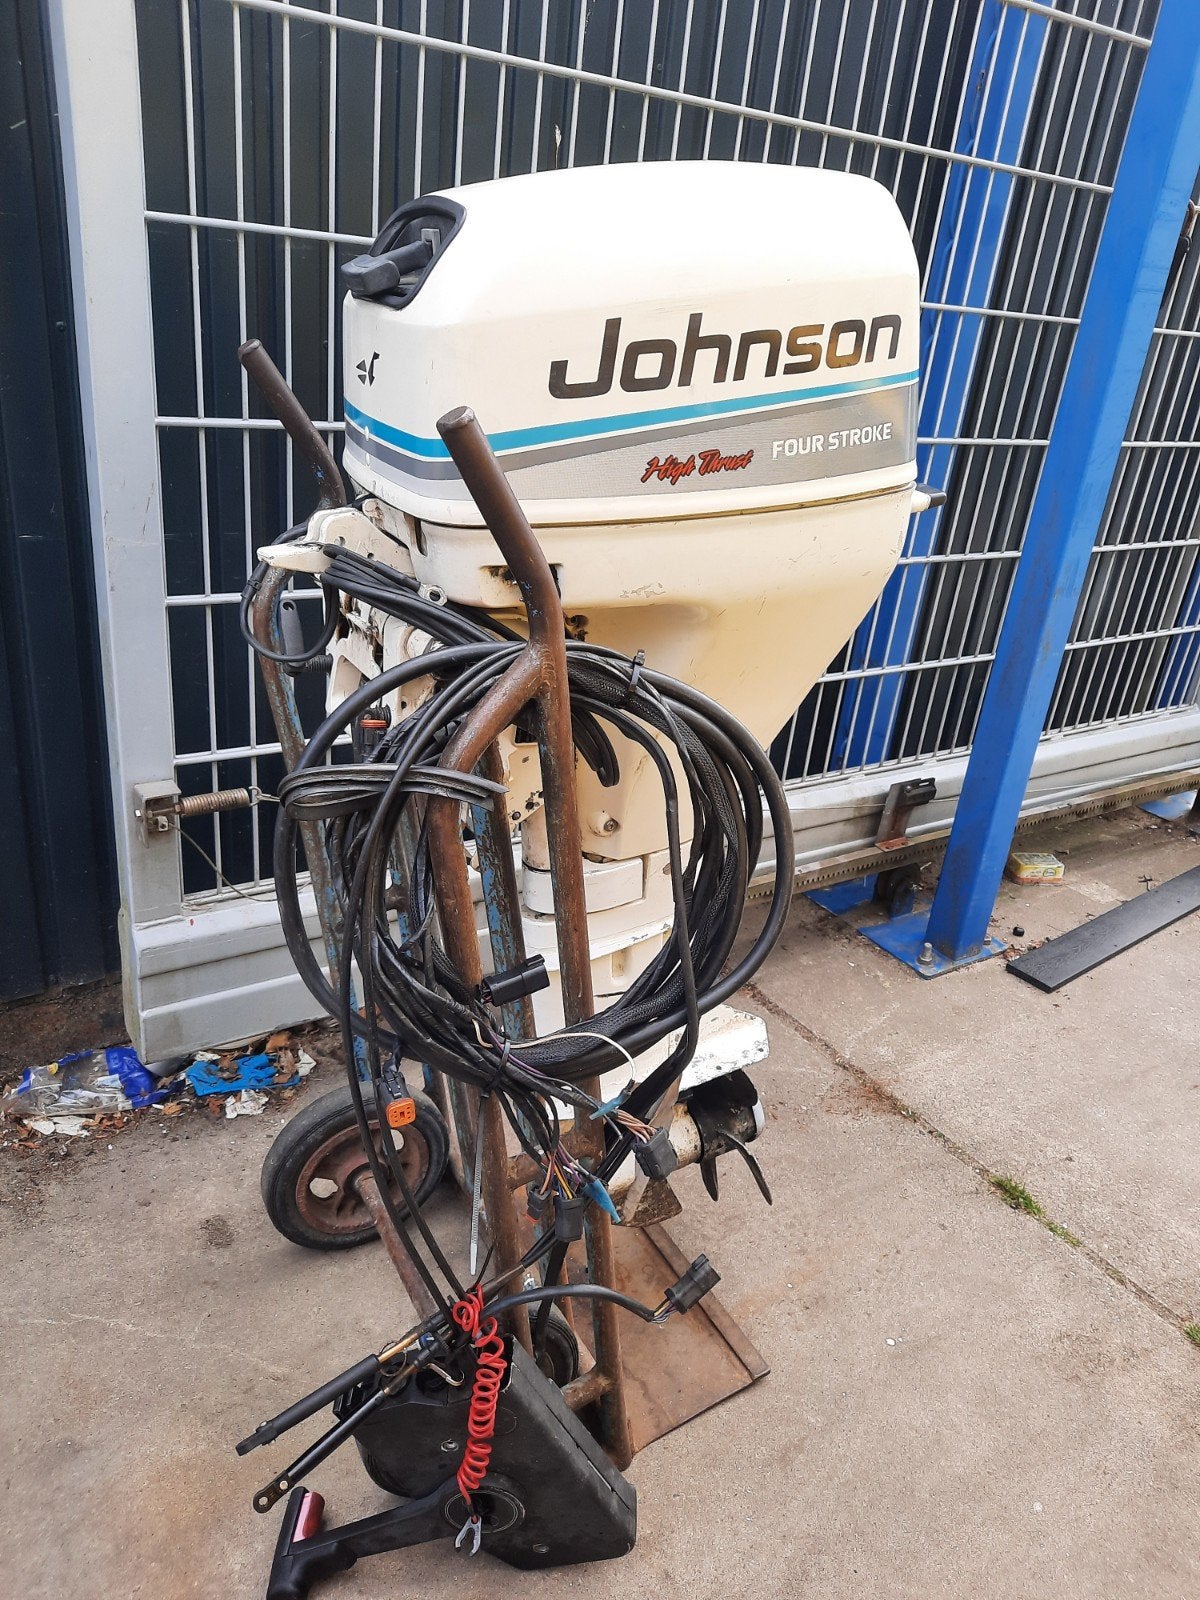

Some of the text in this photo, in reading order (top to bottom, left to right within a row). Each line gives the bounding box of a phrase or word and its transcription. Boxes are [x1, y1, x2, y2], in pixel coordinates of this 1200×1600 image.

[548, 313, 902, 399] Johnson
[772, 422, 893, 461] FOUR STROKE
[640, 449, 756, 486] High Thrust
